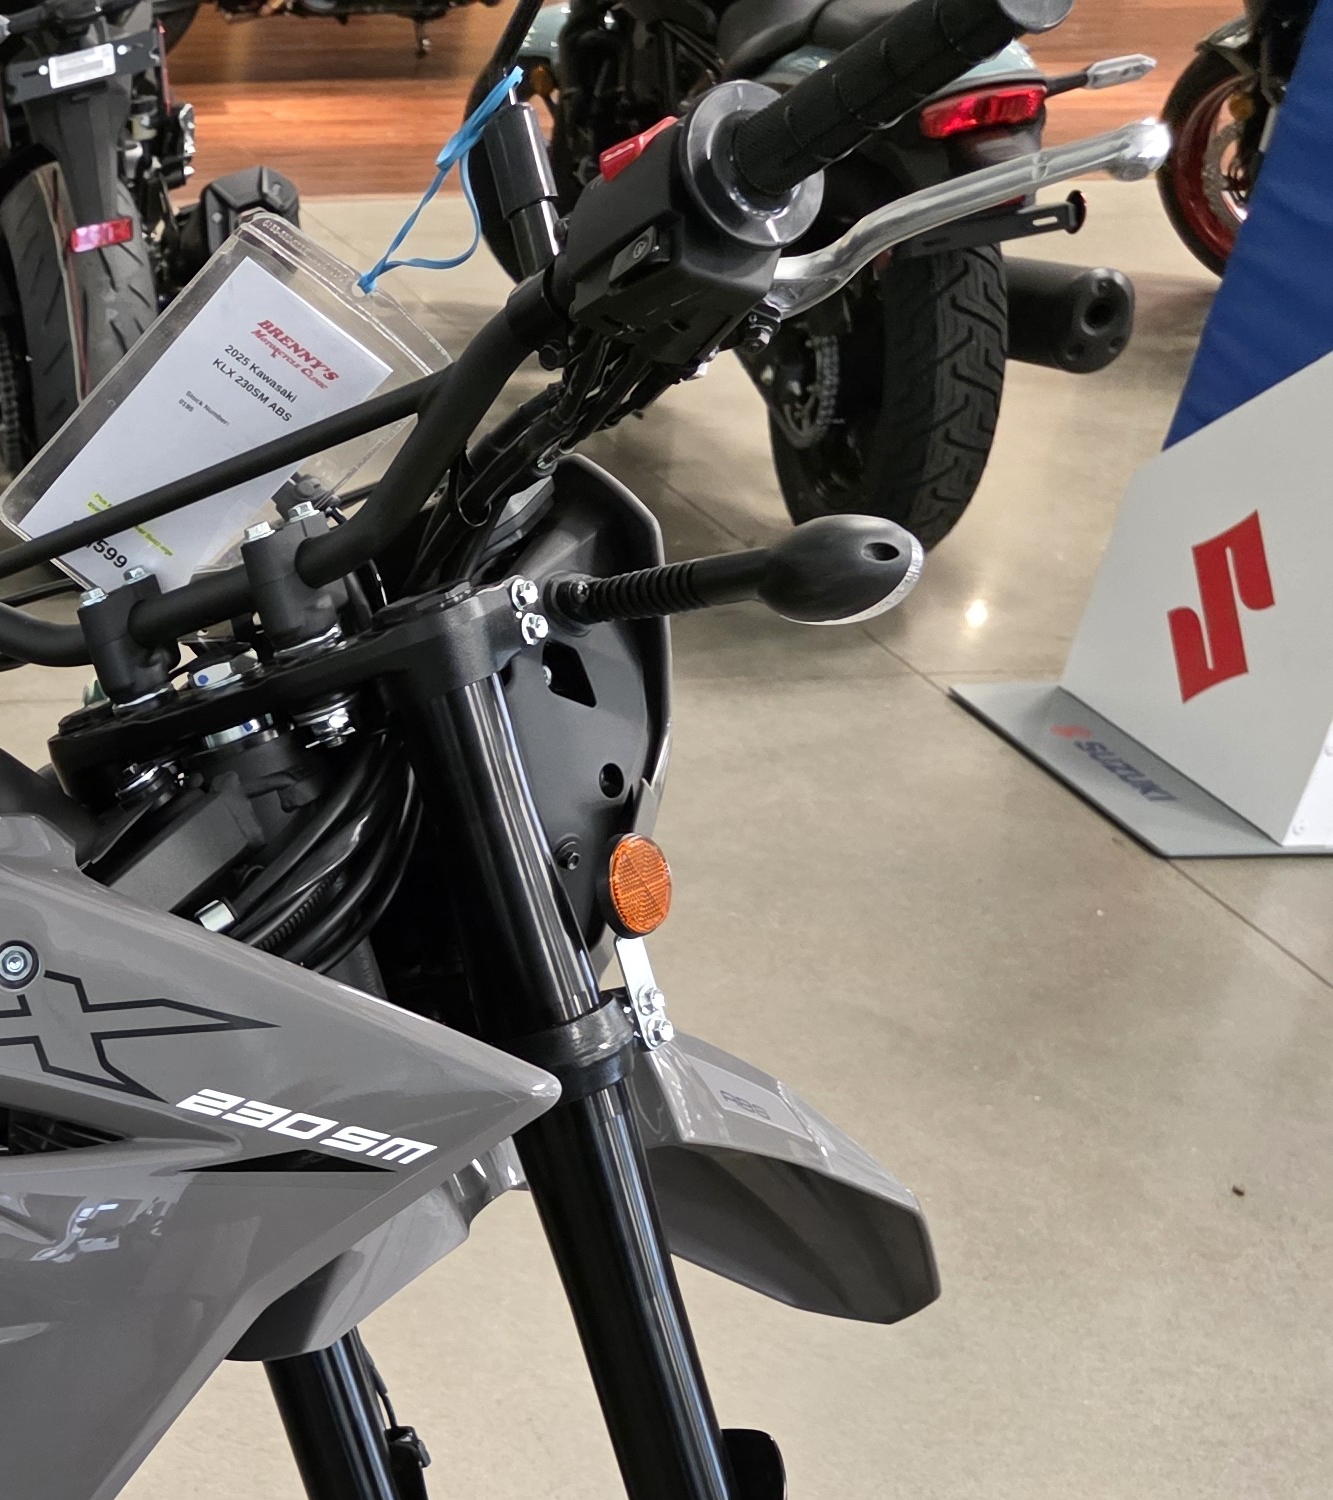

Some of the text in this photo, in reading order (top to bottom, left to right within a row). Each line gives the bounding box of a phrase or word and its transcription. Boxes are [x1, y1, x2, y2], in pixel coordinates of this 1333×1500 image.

[224, 344, 298, 404] 2025 Kawasaki
[257, 319, 340, 382] BRENNY'S
[212, 358, 293, 423] KLX 230SM ABS
[1075, 741, 1179, 802] SUZUKI
[719, 1089, 772, 1121] ABS
